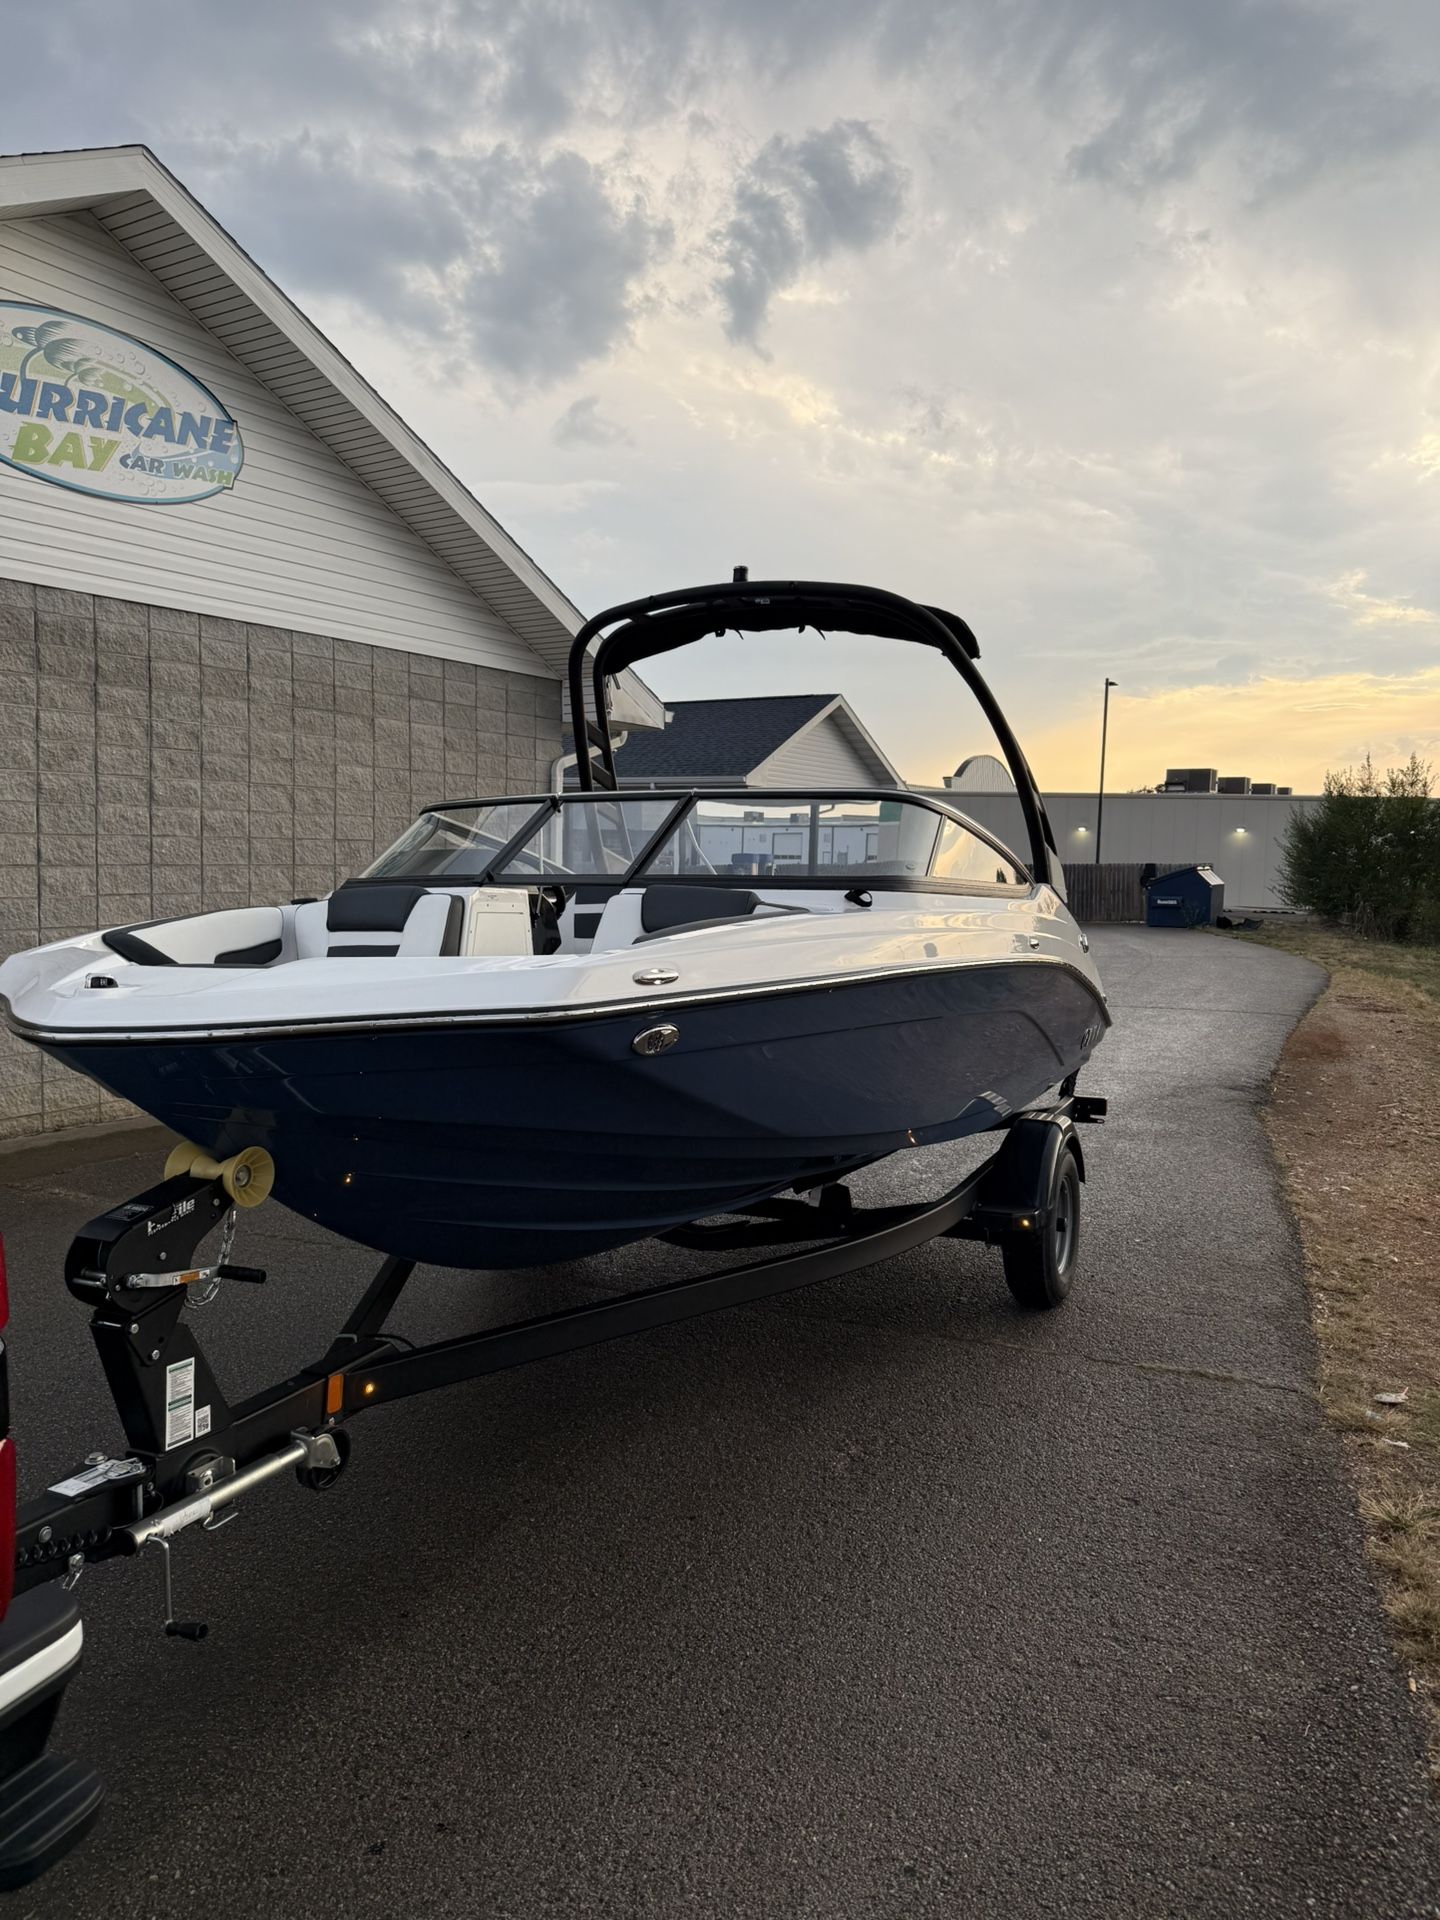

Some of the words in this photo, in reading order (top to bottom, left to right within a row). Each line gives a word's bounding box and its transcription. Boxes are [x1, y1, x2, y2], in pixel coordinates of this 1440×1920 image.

[0, 371, 234, 454] URRICANE
[9, 421, 120, 472] BAY
[119, 453, 164, 474] CAR
[173, 462, 233, 486] WASH
